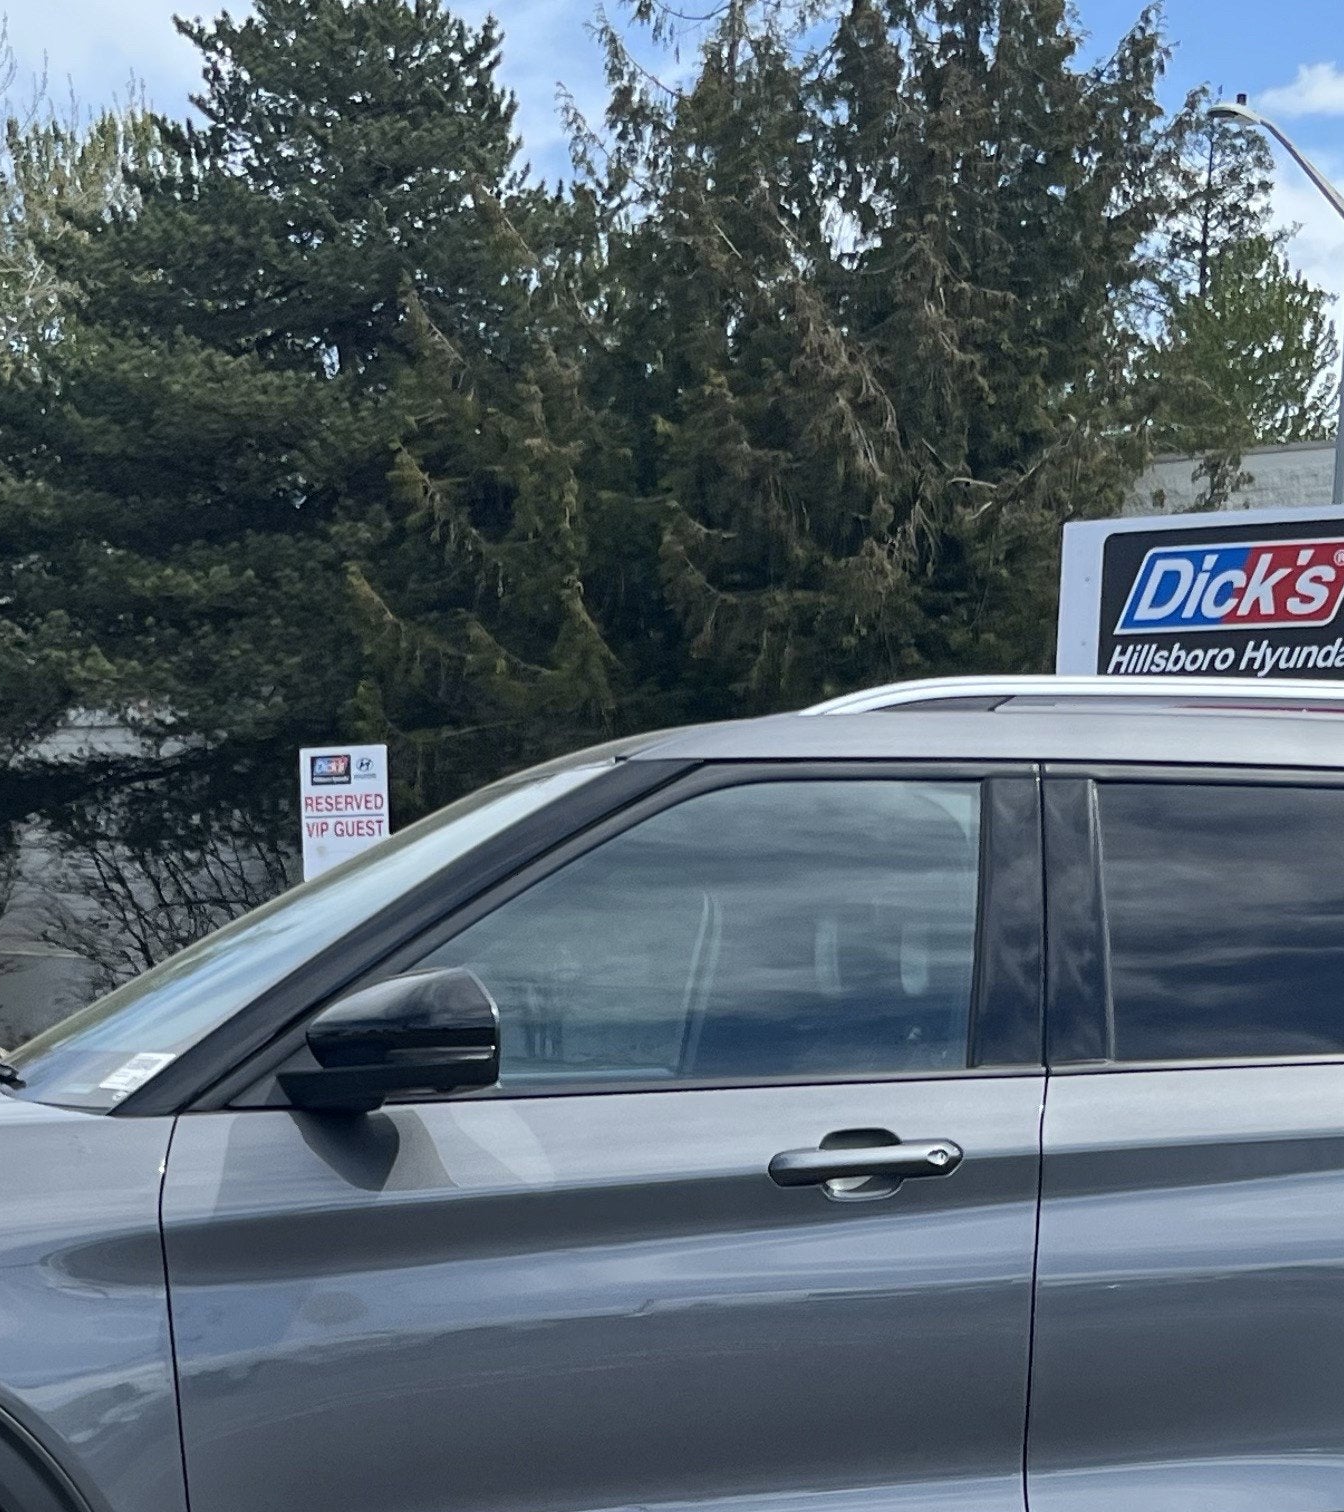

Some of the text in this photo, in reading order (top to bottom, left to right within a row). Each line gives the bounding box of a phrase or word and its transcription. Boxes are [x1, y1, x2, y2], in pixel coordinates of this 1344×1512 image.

[1133, 549, 1337, 621] Dick's
[1107, 642, 1235, 674] Hillsboro
[305, 793, 384, 813] RESERVED
[307, 820, 384, 838] VIP GUEST
